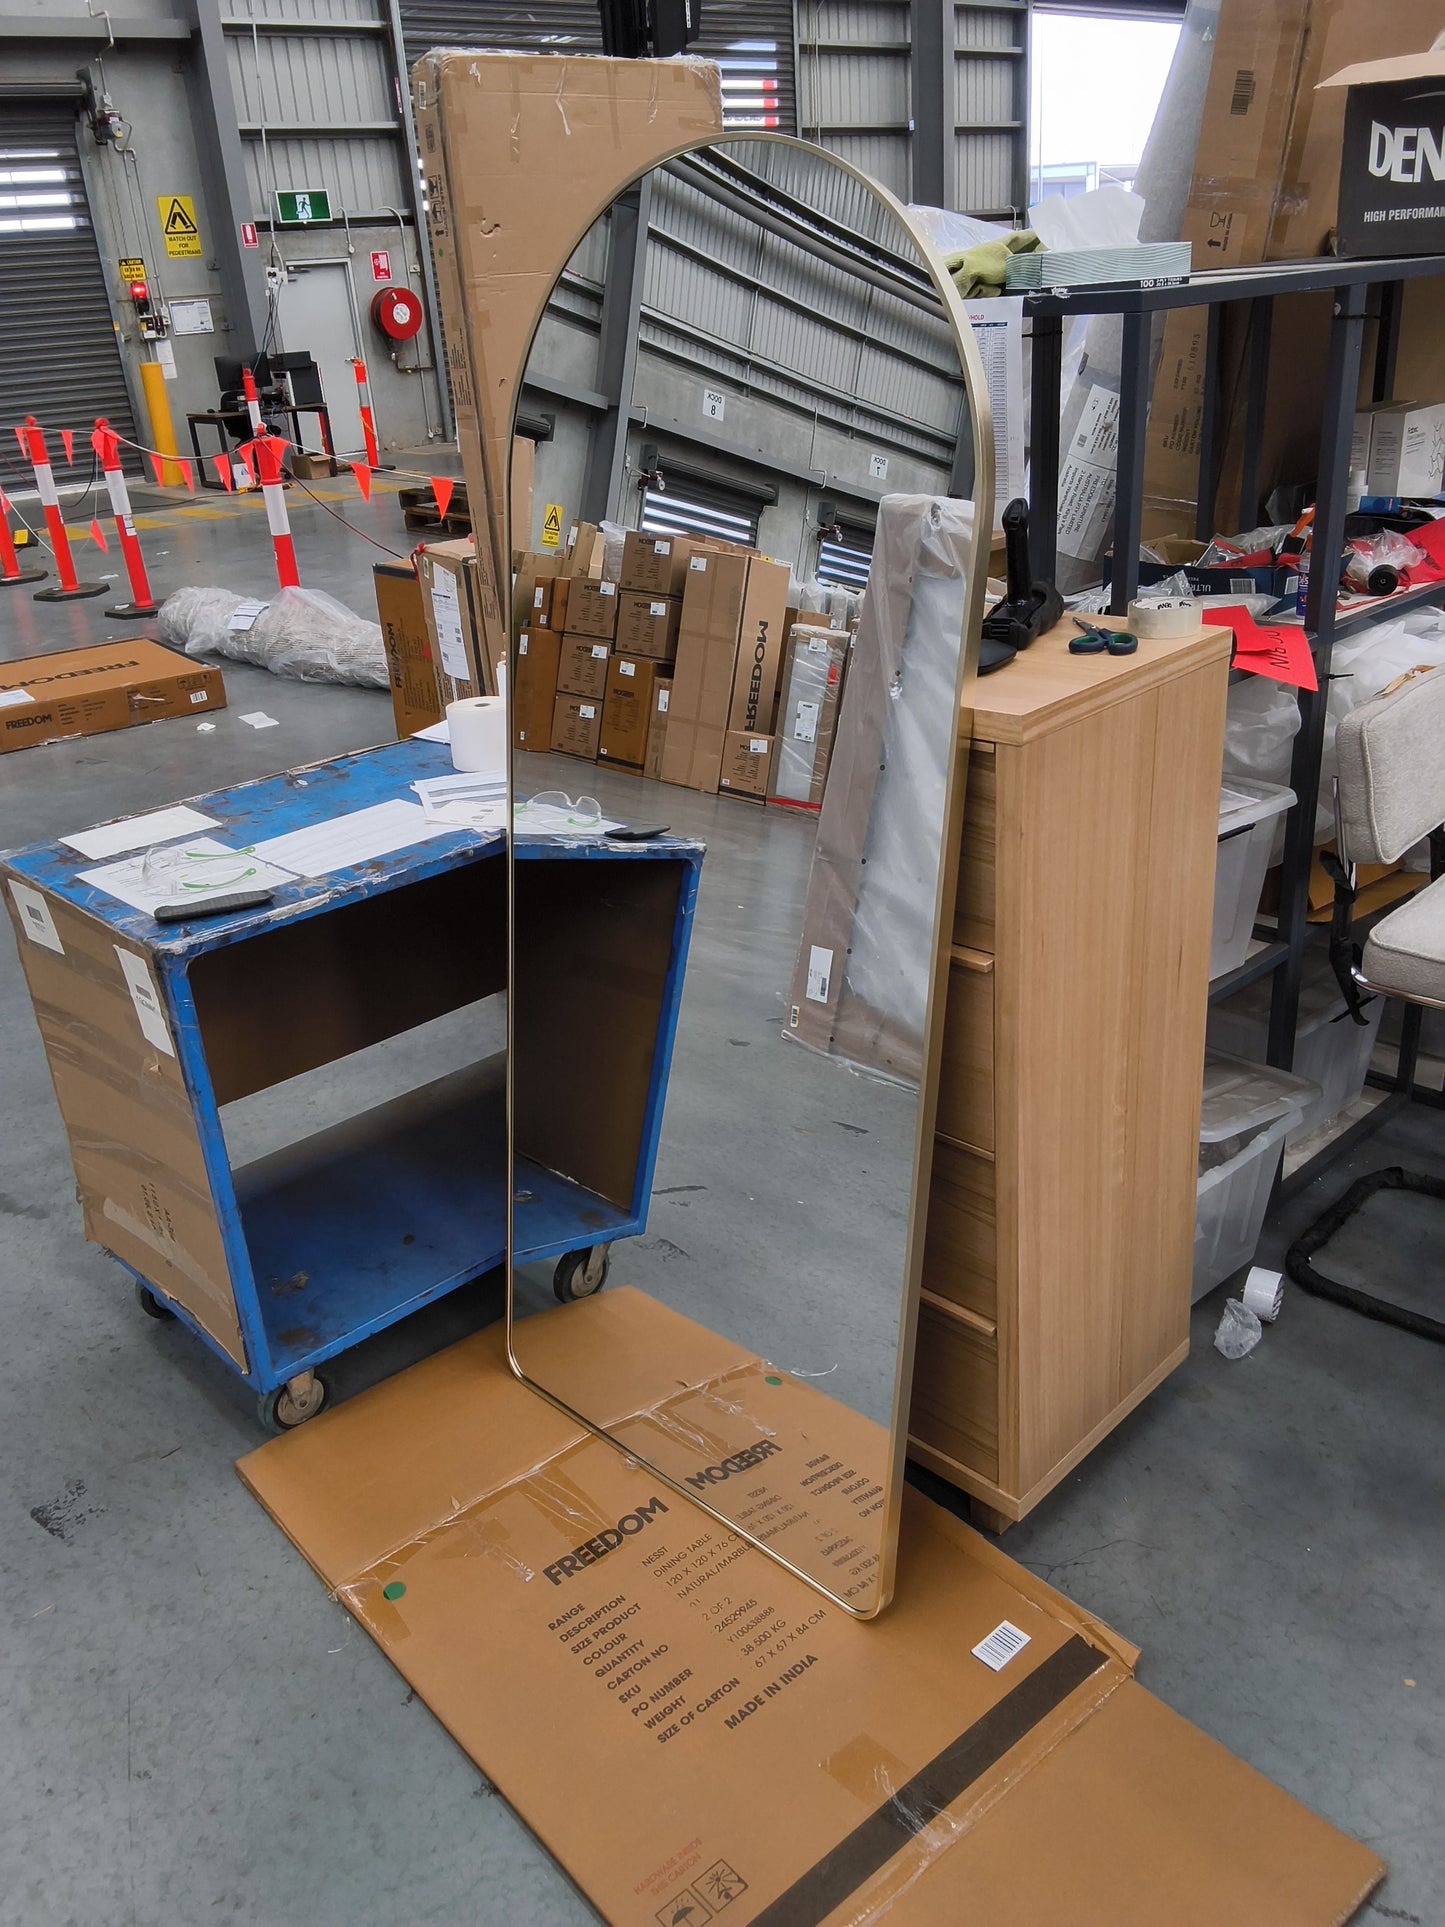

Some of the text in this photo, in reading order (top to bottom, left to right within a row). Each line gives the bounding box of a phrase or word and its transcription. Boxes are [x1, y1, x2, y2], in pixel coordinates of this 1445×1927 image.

[1364, 211, 1386, 223] HIGH
[1140, 279, 1154, 288] 100
[1062, 465, 1072, 487] Australia
[1074, 475, 1083, 491] Harvey
[1078, 473, 1092, 502] AUSTRALIA
[1074, 476, 1100, 532] FREEDOM FURNITURE
[1066, 514, 1076, 534] LIMITED
[6, 713, 52, 730] FREEDOM
[542, 1496, 669, 1586] FREEDOM
[642, 1546, 668, 1566] NESST
[654, 1534, 712, 1577] DINING TABLE
[666, 1574, 683, 1586] 120
[682, 1567, 692, 1575] X
[691, 1555, 708, 1568] 120
[707, 1549, 716, 1557] X
[716, 1541, 728, 1550] 76
[678, 1540, 754, 1598] NATURAL/MARBLE
[548, 1604, 585, 1630] RANGE
[560, 1596, 625, 1642] DESCRIPTION
[702, 1613, 710, 1621] 2
[710, 1602, 723, 1614] OF
[715, 1599, 757, 1632] 24529945
[727, 1607, 774, 1642] Y100638888
[770, 1620, 785, 1632] KG
[571, 1603, 640, 1654] SIZE PRODUCT
[755, 1610, 826, 1667] 67 X 67 X 84 CM
[583, 1633, 627, 1665] COLOUR
[595, 1640, 644, 1677] QUANTITY
[608, 1645, 668, 1689] CARTON NO
[619, 1685, 641, 1703] SKU
[632, 1669, 692, 1716] PO NUMBER
[725, 1655, 818, 1729] MADE IN INDIA
[644, 1696, 685, 1728] WEIGHT
[658, 1678, 740, 1743] SIZE OF CARTON
[668, 1853, 701, 1881] CARTON
